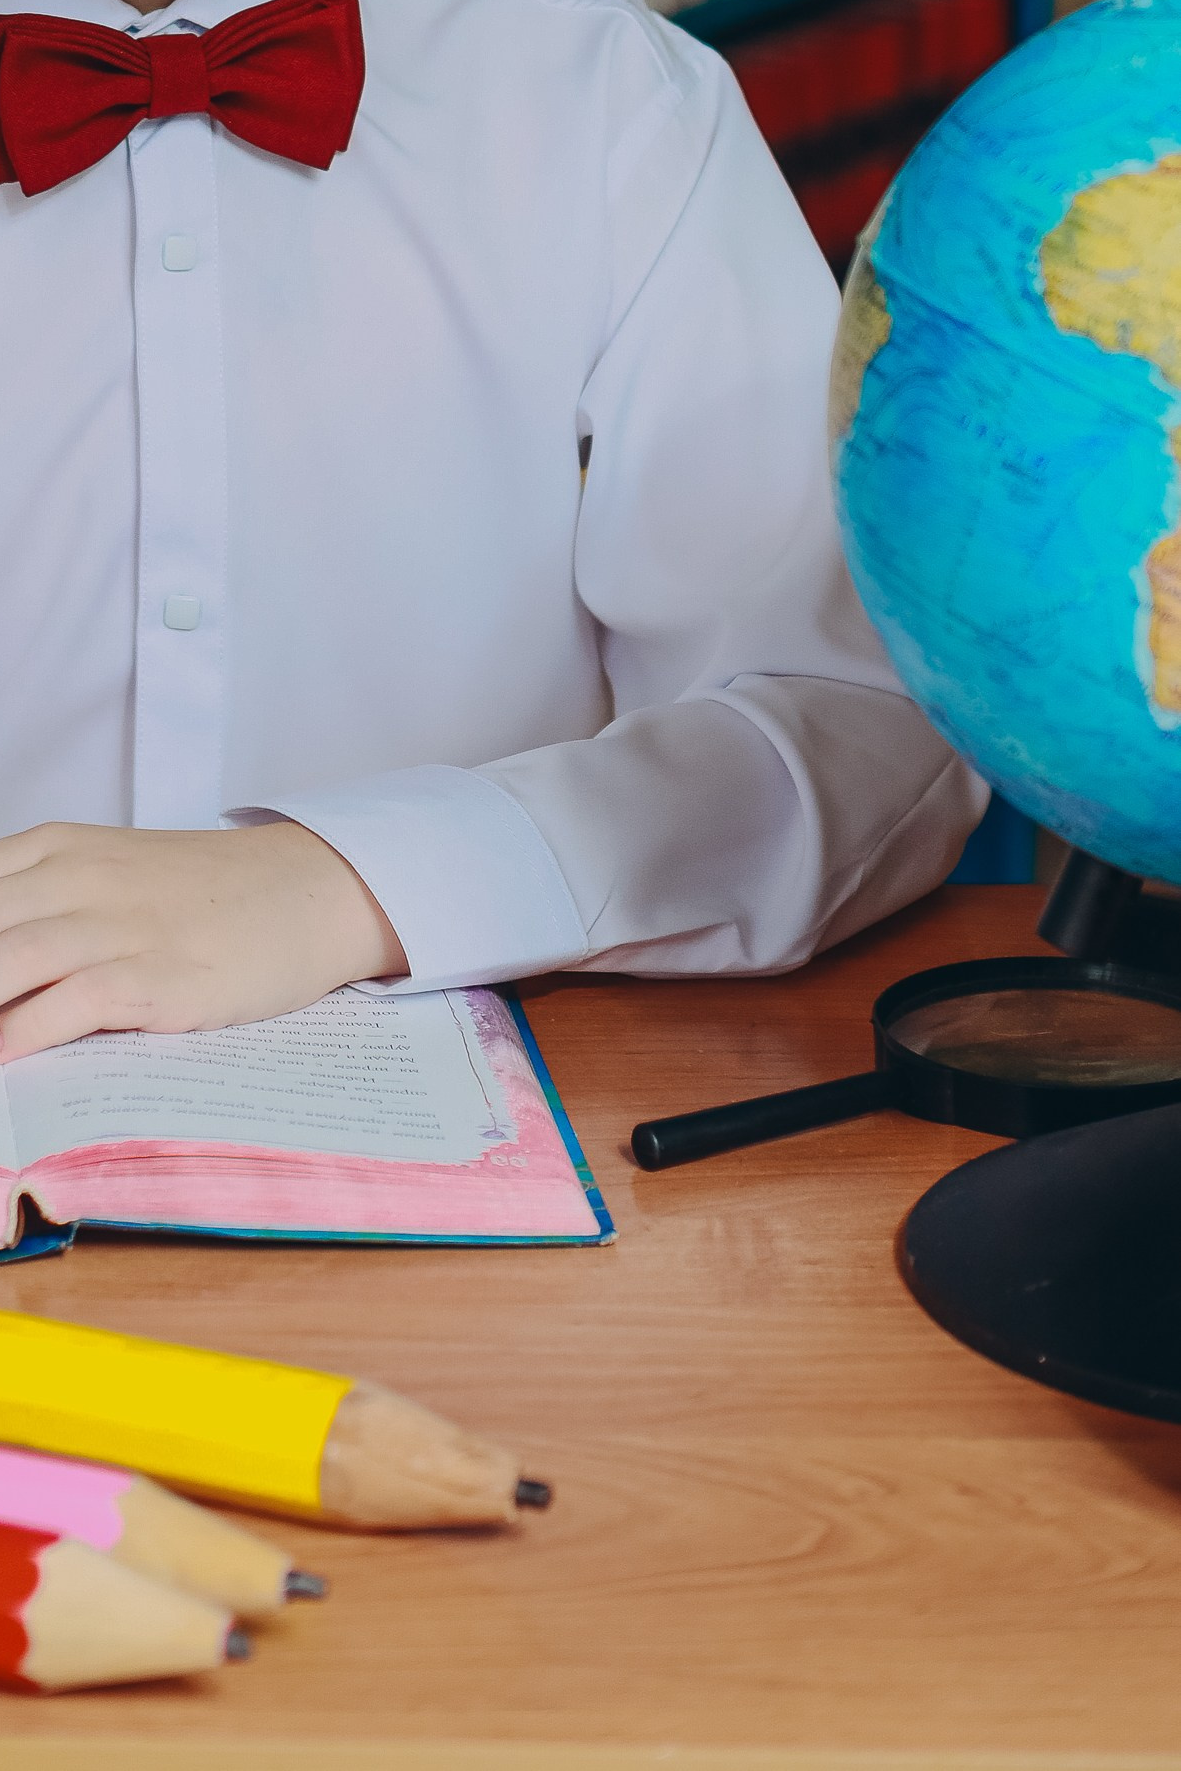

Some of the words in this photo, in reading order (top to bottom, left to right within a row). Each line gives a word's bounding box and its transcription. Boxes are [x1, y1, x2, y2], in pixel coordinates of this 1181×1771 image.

[338, 1021, 384, 1029] Толпа
[217, 1034, 272, 1043] потому
[282, 1040, 350, 1049] Избенку,
[361, 1043, 410, 1051] дурачу
[264, 1050, 338, 1058] добавила,
[160, 1055, 240, 1068] подружка!
[248, 1065, 276, 1073] моя
[310, 1073, 375, 1083] Избенка
[241, 1085, 333, 1098] собирается
[350, 1097, 383, 1105] Она
